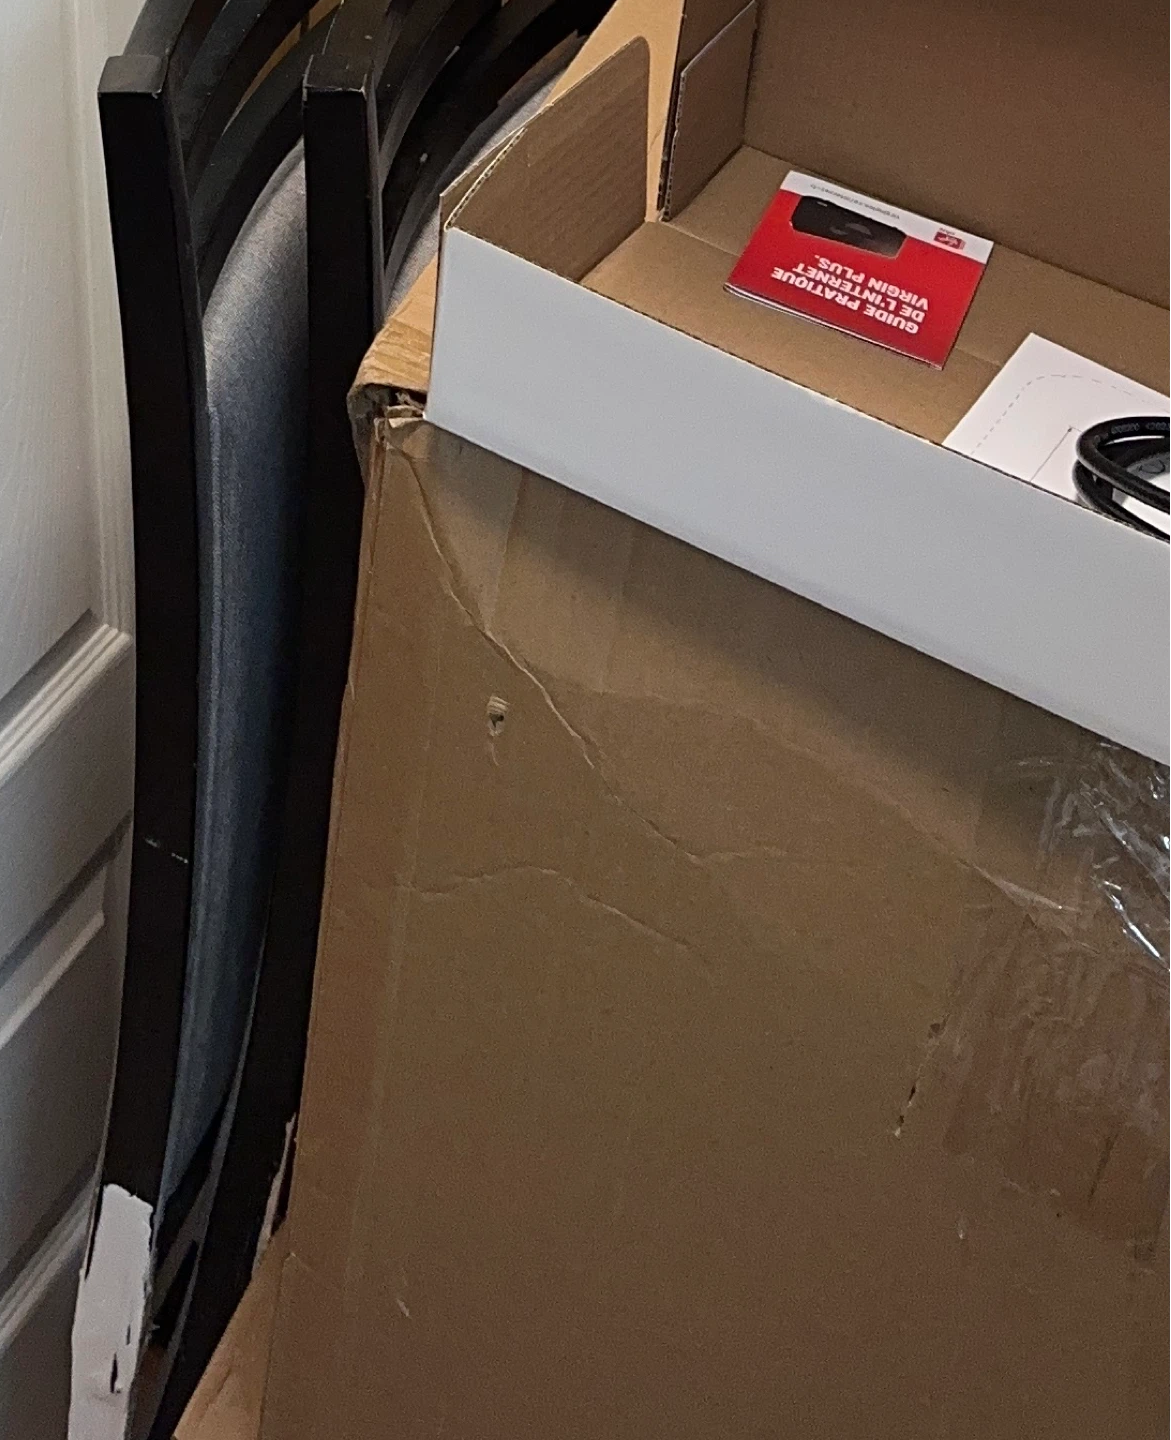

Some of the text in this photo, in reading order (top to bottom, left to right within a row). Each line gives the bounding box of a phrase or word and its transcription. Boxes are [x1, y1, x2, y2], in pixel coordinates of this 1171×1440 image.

[771, 266, 919, 334] GUIDE PRATIQUE
[792, 263, 926, 323] DE L'INTERNET
[814, 254, 929, 311] VIRGIN PLUS.
